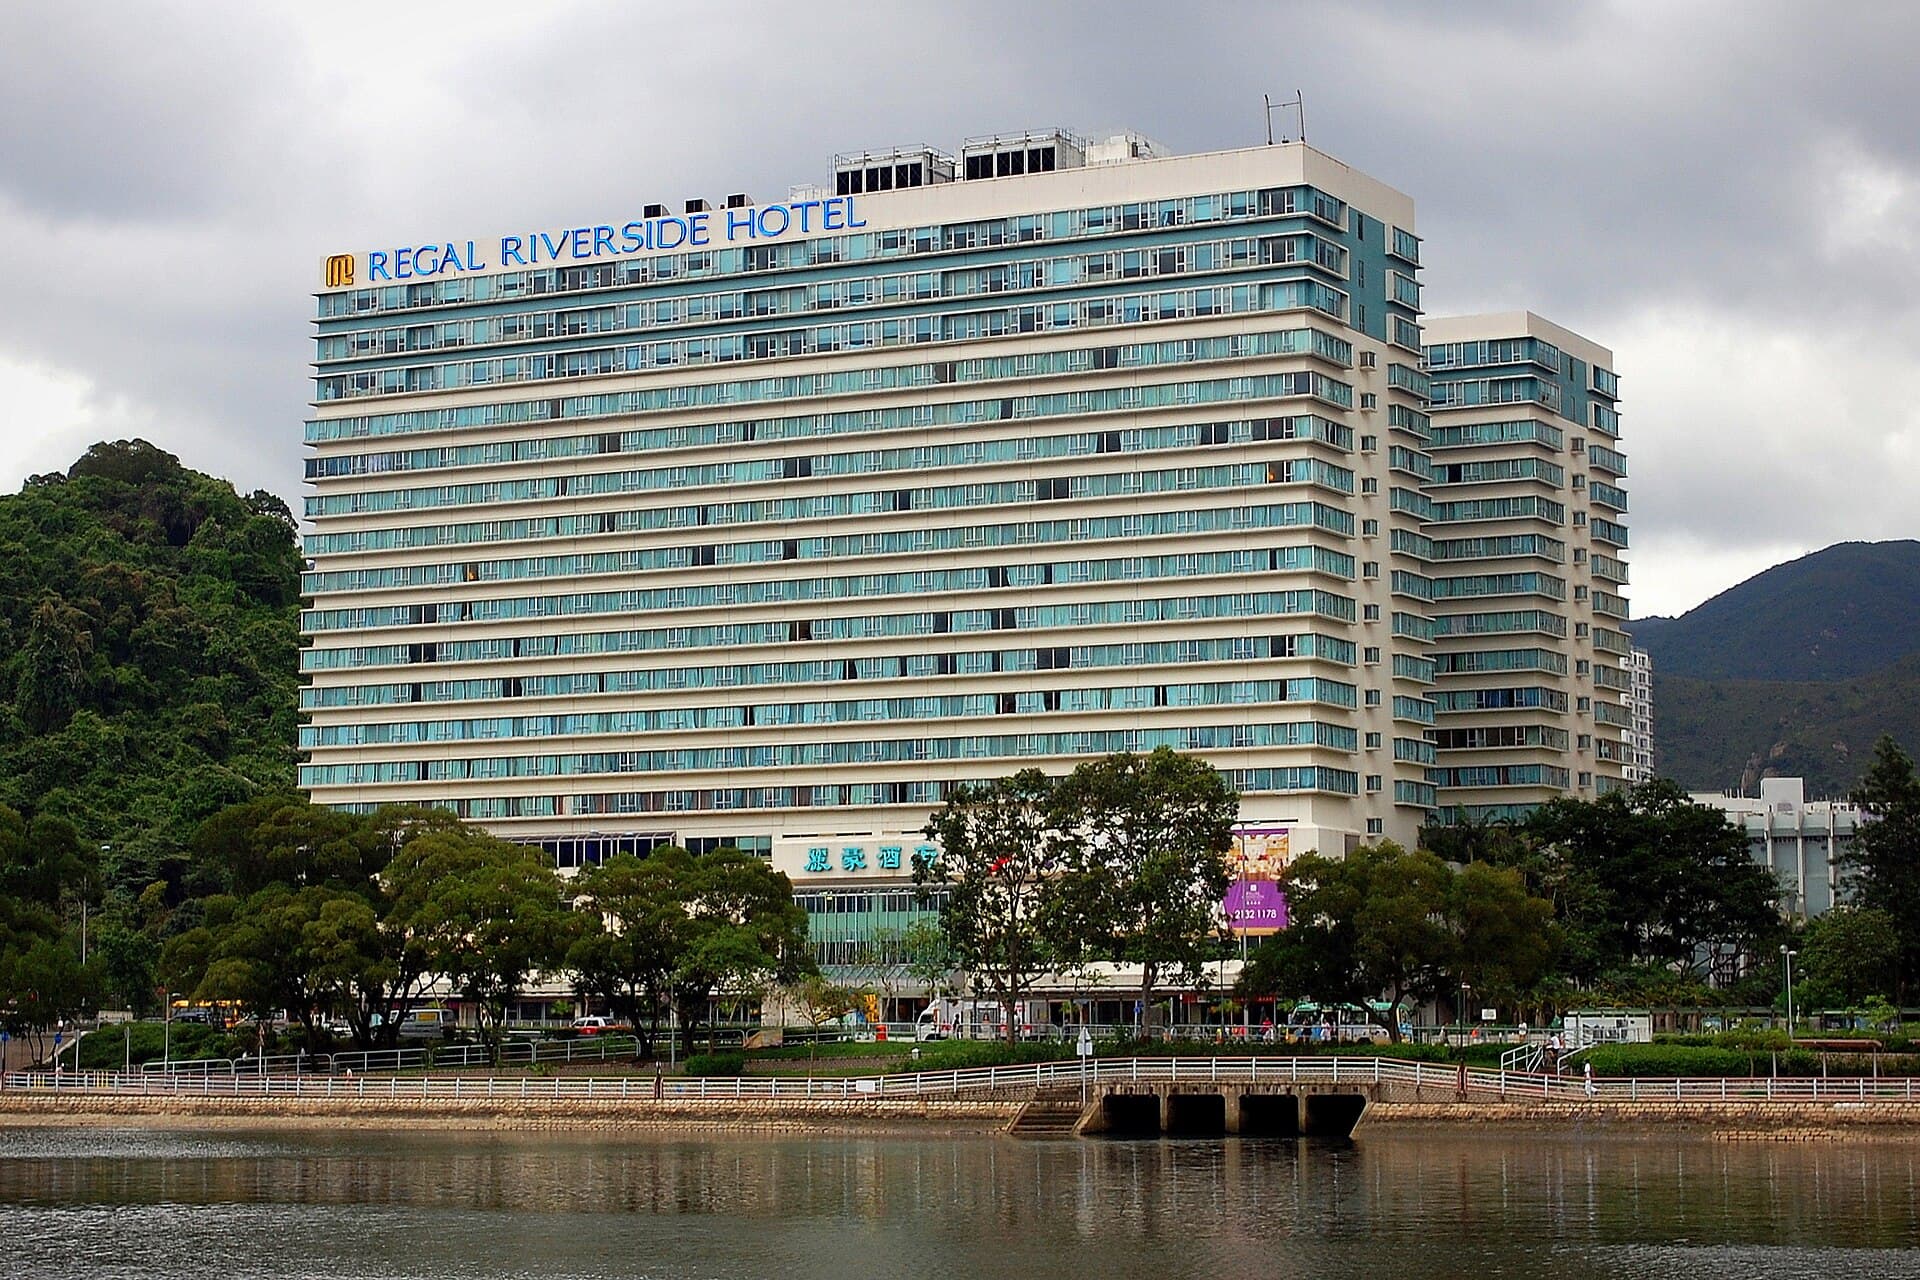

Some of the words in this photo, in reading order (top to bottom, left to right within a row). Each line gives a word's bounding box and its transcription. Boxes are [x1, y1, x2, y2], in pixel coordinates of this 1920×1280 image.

[369, 242, 486, 281] REGAL
[501, 214, 709, 265] RIVERSIDE
[727, 196, 867, 241] HOTEL
[1235, 909, 1255, 919] 2132
[1257, 909, 1277, 919] 1178
